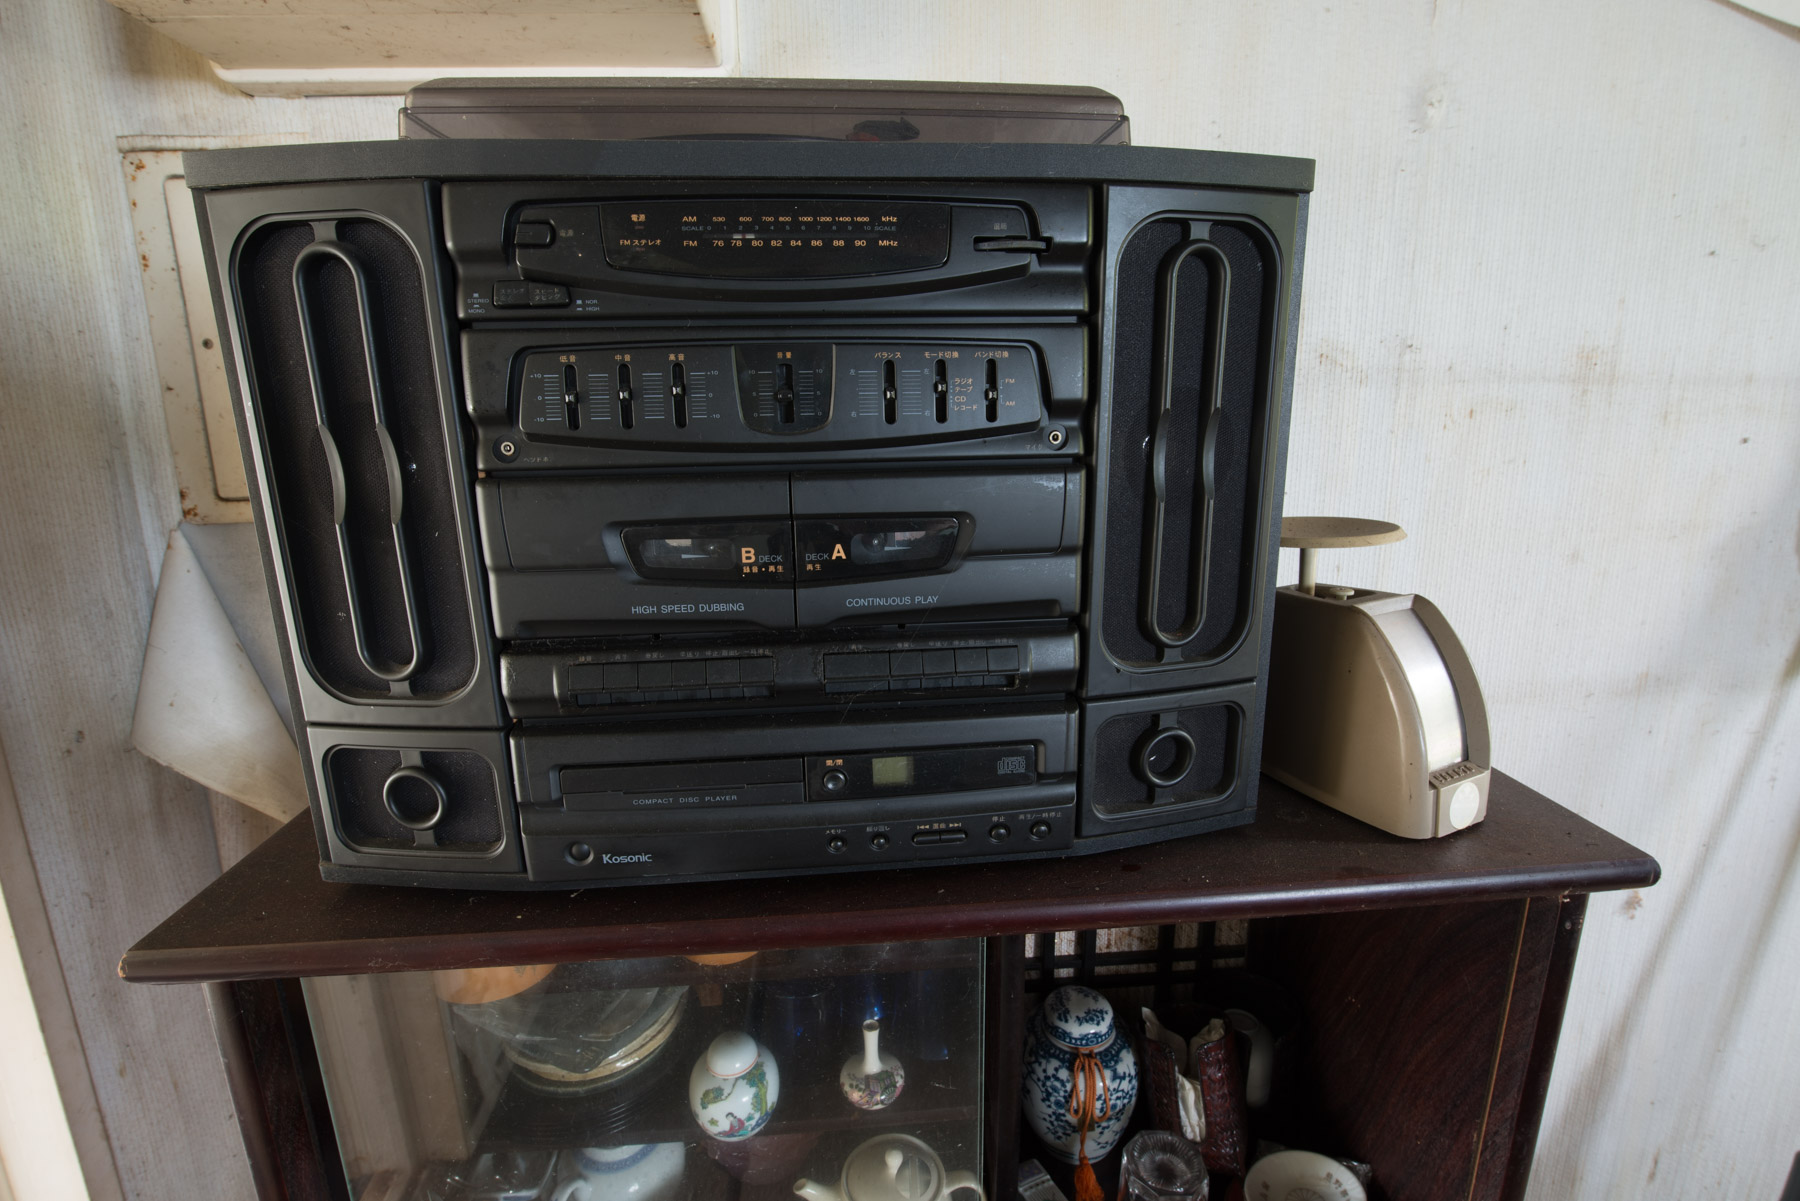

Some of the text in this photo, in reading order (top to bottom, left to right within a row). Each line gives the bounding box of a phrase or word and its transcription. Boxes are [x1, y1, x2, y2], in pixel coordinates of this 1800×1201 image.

[632, 238, 662, 247] ステレオ
[560, 355, 576, 363] 低音
[614, 354, 632, 362] 中音
[668, 353, 685, 361] 高音
[741, 548, 783, 564] B DECK
[806, 544, 847, 560] DECK A
[846, 596, 939, 608] CONTINUOUS PLAY
[632, 602, 744, 614] HIGH SPEED DUBBING
[633, 798, 674, 806] COMPACT
[705, 794, 738, 802] PLAYER
[602, 853, 652, 864] Kosonic
